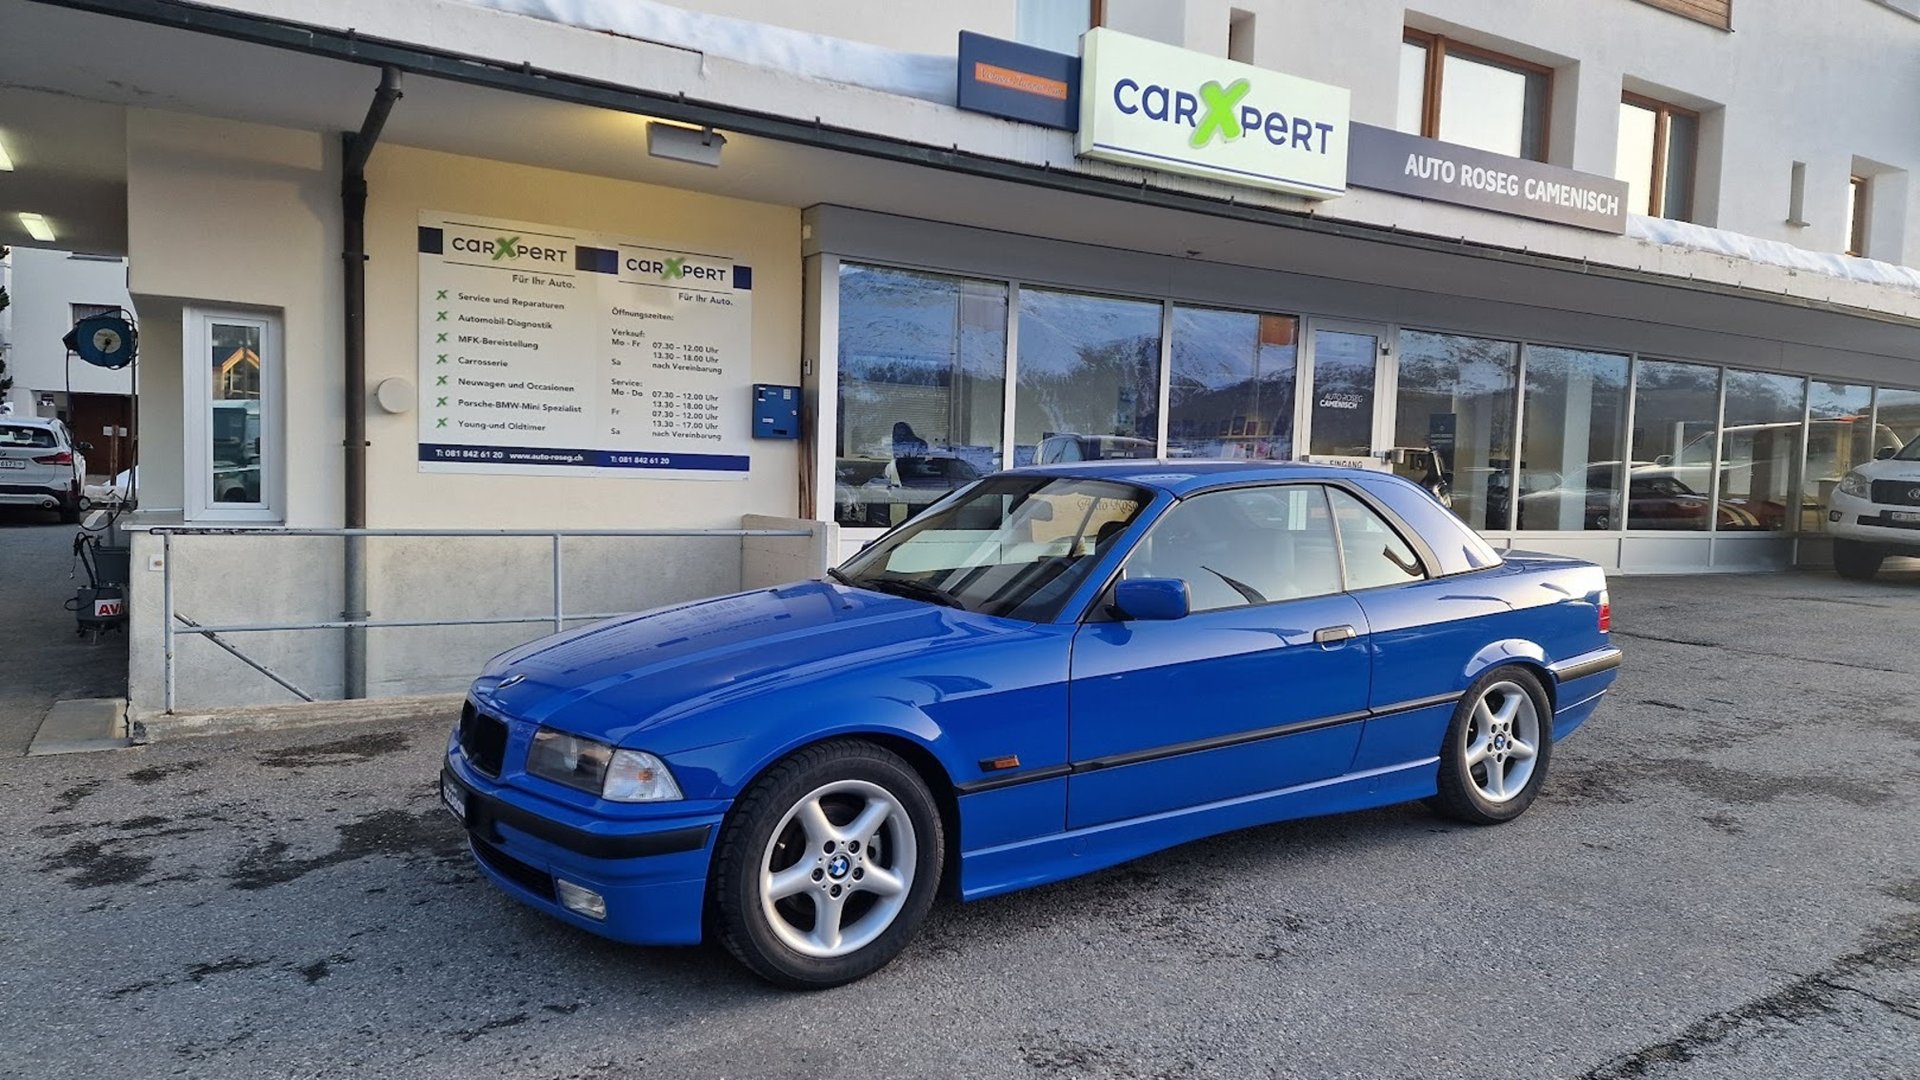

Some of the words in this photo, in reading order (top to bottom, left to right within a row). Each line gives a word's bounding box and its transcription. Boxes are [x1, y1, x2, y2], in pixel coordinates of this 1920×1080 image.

[1405, 153, 1455, 183] AUTO
[1461, 164, 1519, 196] ROSEG
[1524, 178, 1619, 216] CAMENISCH
[512, 275, 529, 284] Für
[532, 277, 545, 285] Ihr
[549, 279, 575, 289] Auto.
[458, 293, 490, 302] Service
[493, 297, 509, 305] und
[512, 299, 564, 309] Reparaturen
[678, 293, 693, 301] Für
[696, 294, 707, 302] Ihr
[710, 296, 733, 305] Auto.
[612, 307, 674, 320] Öffnungszeiten:
[458, 314, 552, 329] Automobil-Diagnostik
[612, 329, 645, 337] Verkauf:
[458, 335, 538, 350] MFK-Bereistellung
[652, 342, 674, 350] 07.30
[683, 344, 703, 353] 12.00
[706, 346, 719, 354] Uhr
[458, 357, 508, 367] Carrosserie
[654, 352, 674, 360] 13.30
[683, 354, 703, 362] 18.00
[673, 363, 722, 375] Vereinbarung
[458, 378, 505, 389] Neuwagen
[527, 383, 574, 392] Occasionen
[612, 379, 643, 387] Service:
[1343, 394, 1363, 402] ROSEG
[458, 399, 540, 411] Porsche-BMW-Mini
[543, 404, 581, 413] Spezialist
[1320, 400, 1358, 409] CAMENISCH
[458, 421, 505, 430] Young-und
[508, 423, 546, 431] Oldtimer
[672, 431, 721, 441] Vereinbarung
[463, 450, 478, 458] 842
[510, 453, 583, 462] www.auto-roseg.ch
[1330, 460, 1363, 468] EINGANG
